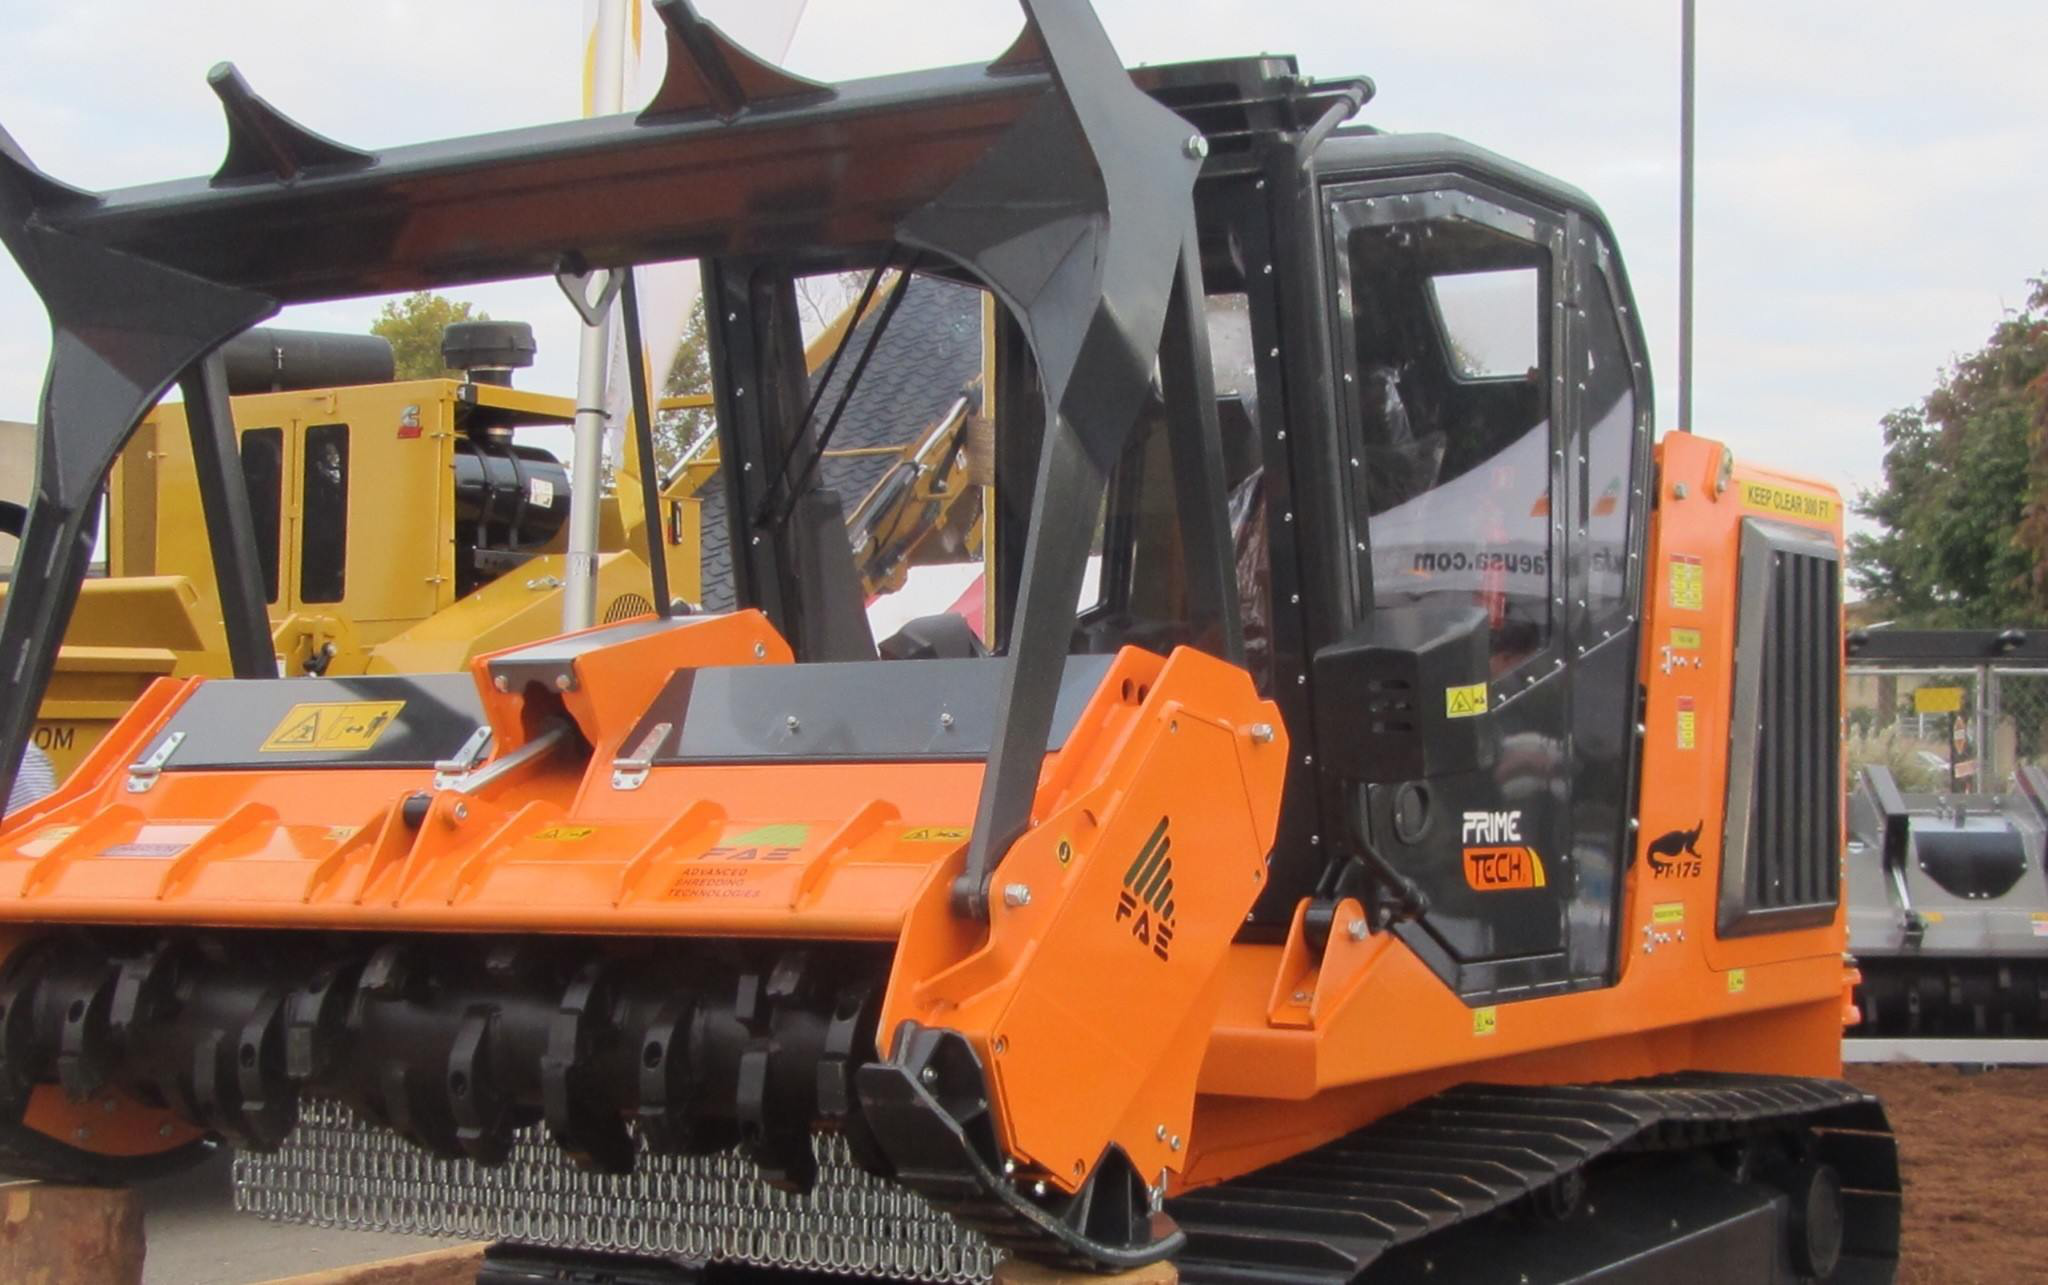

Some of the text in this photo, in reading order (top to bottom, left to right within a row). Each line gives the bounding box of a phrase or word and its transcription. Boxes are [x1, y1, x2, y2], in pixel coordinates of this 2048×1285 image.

[1747, 486, 1772, 507] KEEP
[1773, 490, 1802, 514] CLEAR
[1819, 500, 1830, 518] FT
[1462, 811, 1522, 844] PRIME
[697, 847, 802, 861] FAE
[1470, 853, 1522, 886] TECH
[682, 867, 748, 877] ADVANCED
[667, 888, 761, 898] TECHNOLOGIES
[1115, 890, 1174, 963] FAE
